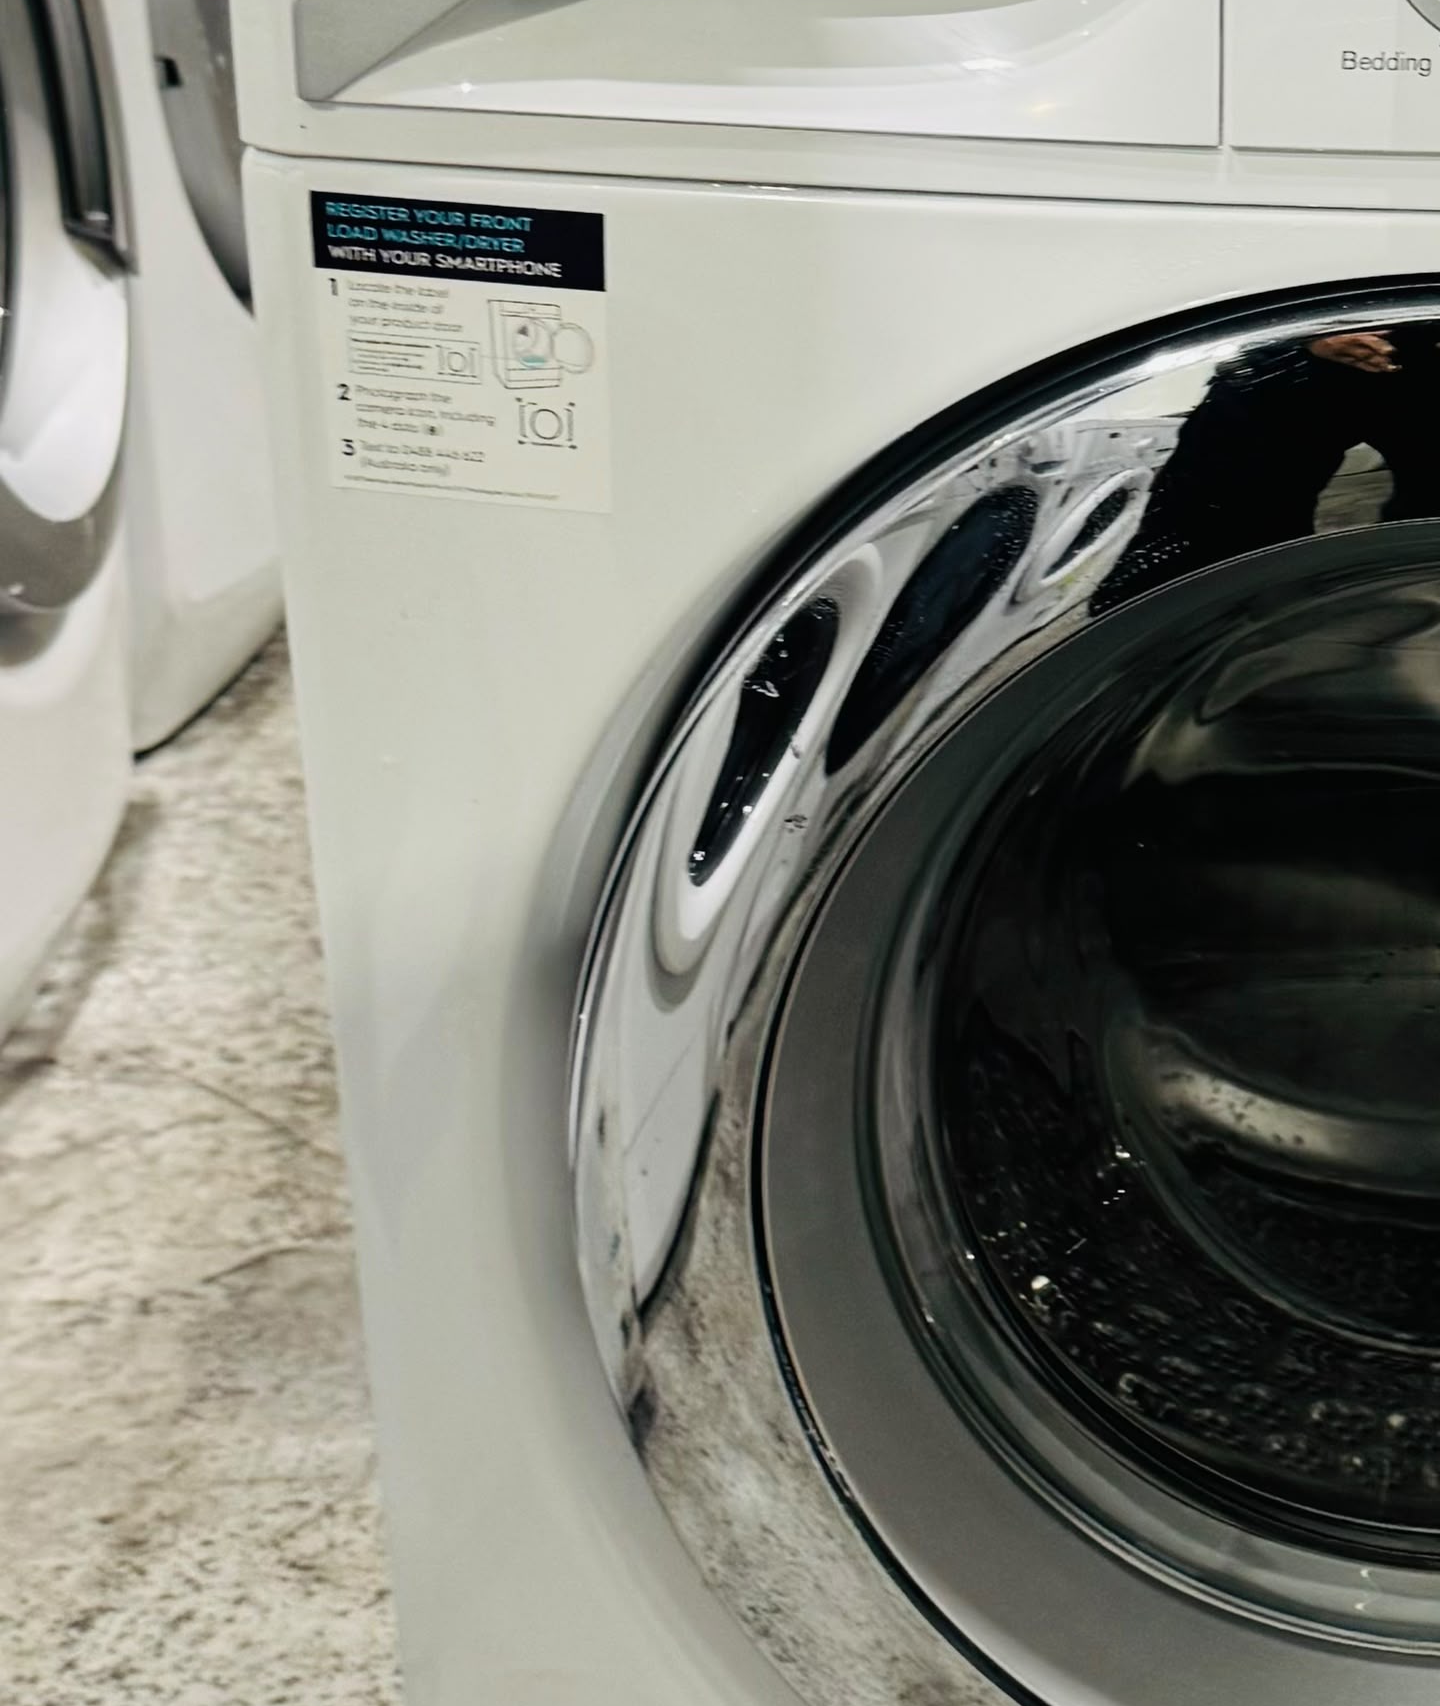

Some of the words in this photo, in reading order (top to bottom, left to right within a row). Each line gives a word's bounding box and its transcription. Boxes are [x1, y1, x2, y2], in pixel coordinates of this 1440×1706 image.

[1341, 51, 1432, 77] Bedding
[325, 201, 410, 222] REGISTER
[414, 208, 466, 227] YOUR
[470, 213, 534, 232] FRONT
[327, 223, 378, 241] LOAD
[382, 228, 526, 253] WASHER/DRYER
[327, 244, 376, 262] WITH
[379, 249, 432, 268] YOUR
[435, 254, 563, 279] SMARTPHONE
[328, 278, 338, 296] 1
[337, 383, 351, 401] 2
[342, 438, 356, 456] 3
